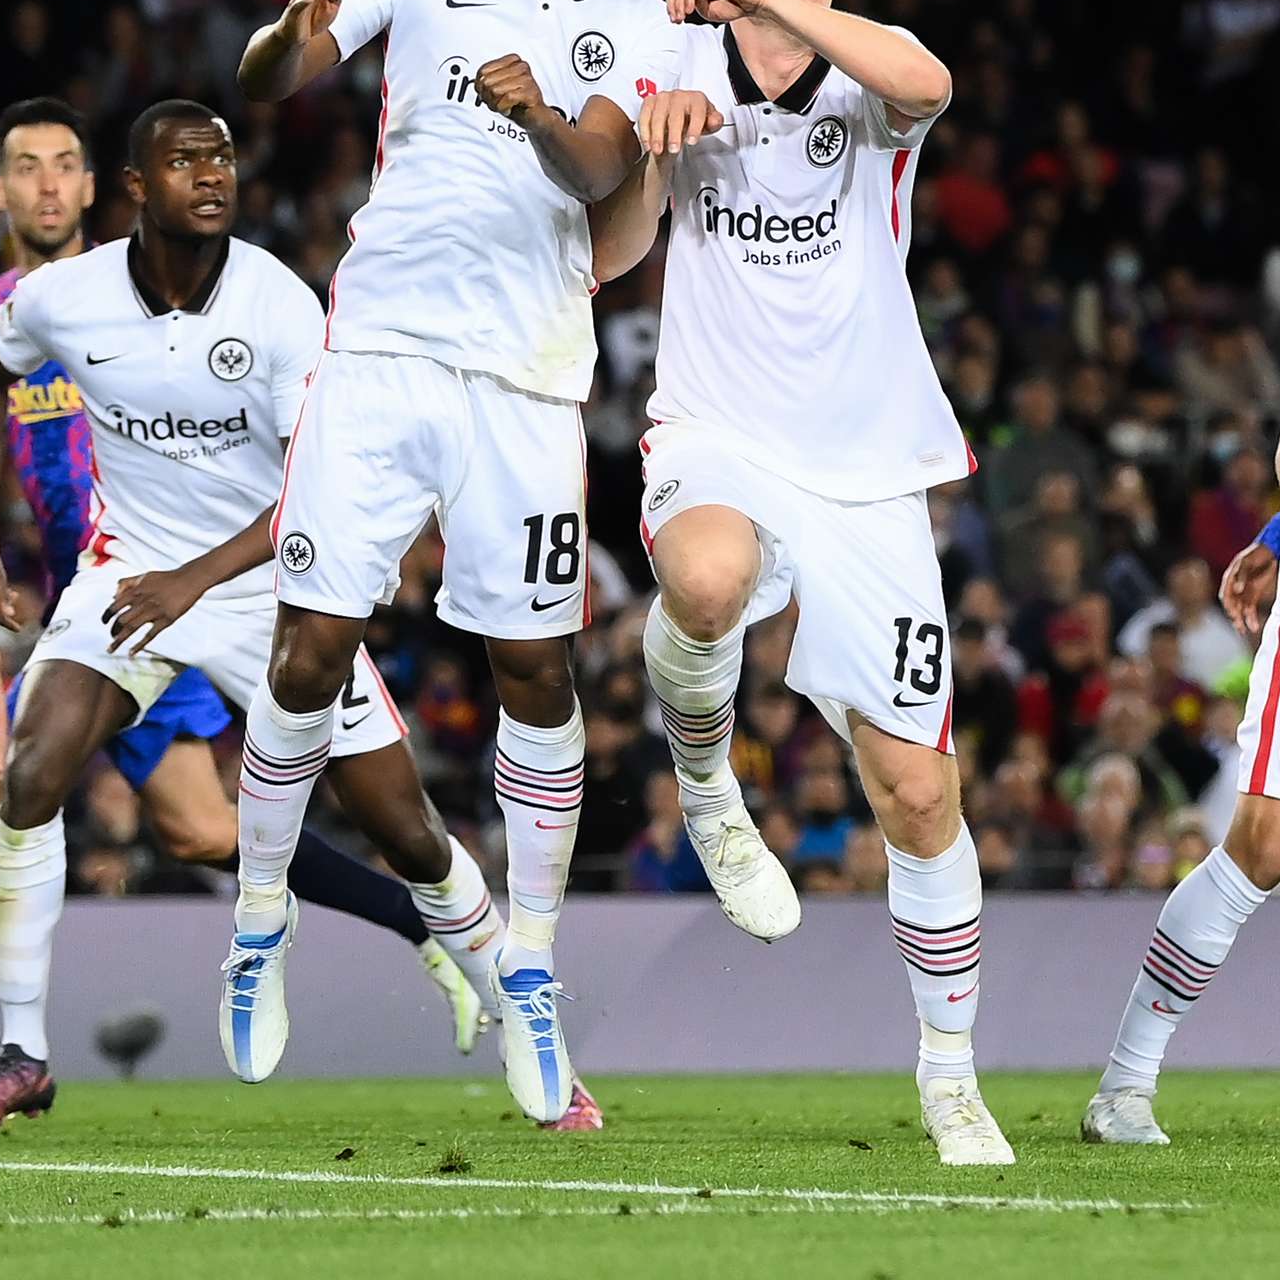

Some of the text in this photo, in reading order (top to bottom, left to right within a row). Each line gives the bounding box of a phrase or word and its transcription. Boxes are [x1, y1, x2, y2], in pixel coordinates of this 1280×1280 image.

[488, 119, 527, 143] Jobs
[704, 195, 838, 243] indeed
[742, 239, 842, 266] Jobs finden
[113, 407, 248, 441] indeed
[523, 512, 581, 586] 18
[893, 617, 944, 696] 13
